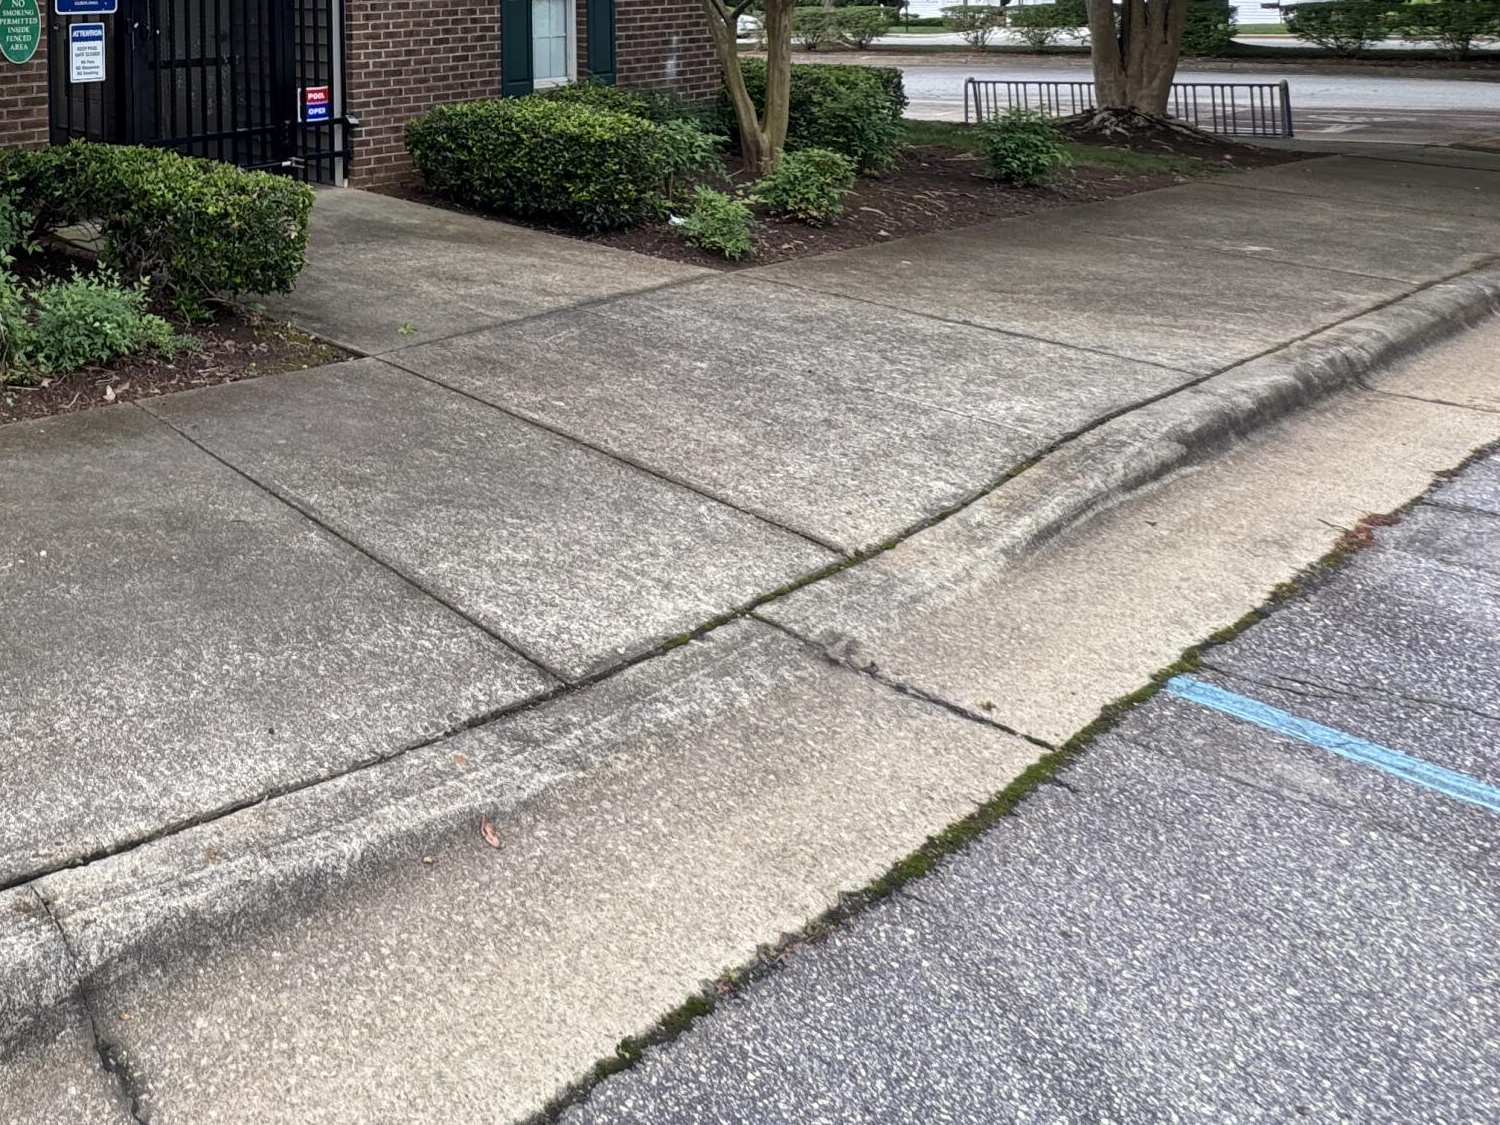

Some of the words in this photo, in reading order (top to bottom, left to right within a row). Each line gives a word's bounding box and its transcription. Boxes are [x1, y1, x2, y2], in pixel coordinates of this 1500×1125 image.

[11, 0, 26, 8] NO
[2, 9, 34, 17] SMOKING
[0, 17, 38, 25] PERMITTED
[7, 26, 30, 34] INSIDE
[5, 34, 32, 42] FENCED
[9, 43, 29, 51] AREA
[307, 92, 326, 100] POOL
[307, 106, 326, 115] OPEN
